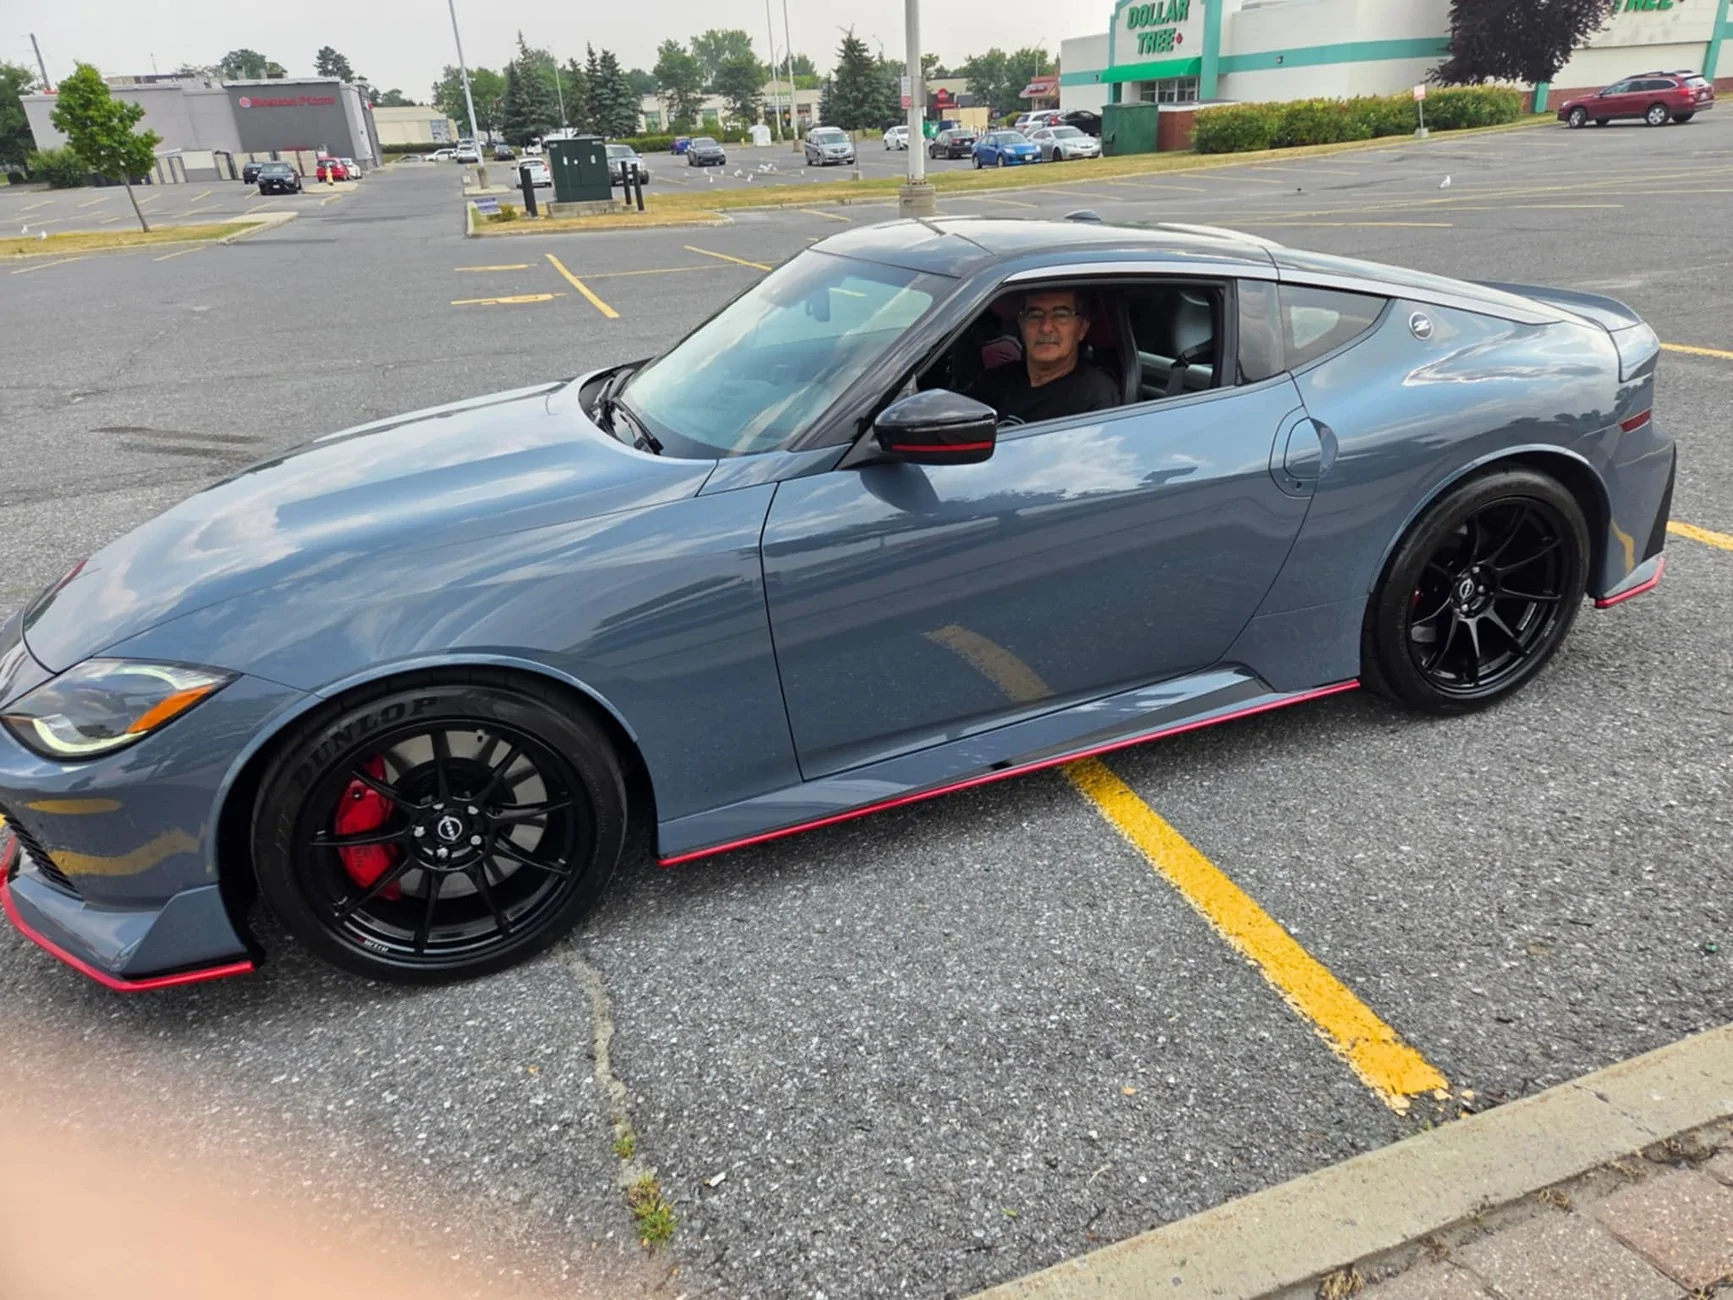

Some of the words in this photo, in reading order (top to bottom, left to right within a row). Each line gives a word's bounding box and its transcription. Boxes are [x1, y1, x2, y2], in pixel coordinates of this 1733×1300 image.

[1127, 0, 1190, 30] DOLLAR
[1137, 27, 1177, 54] TREE
[292, 697, 438, 789] DUNLOP
